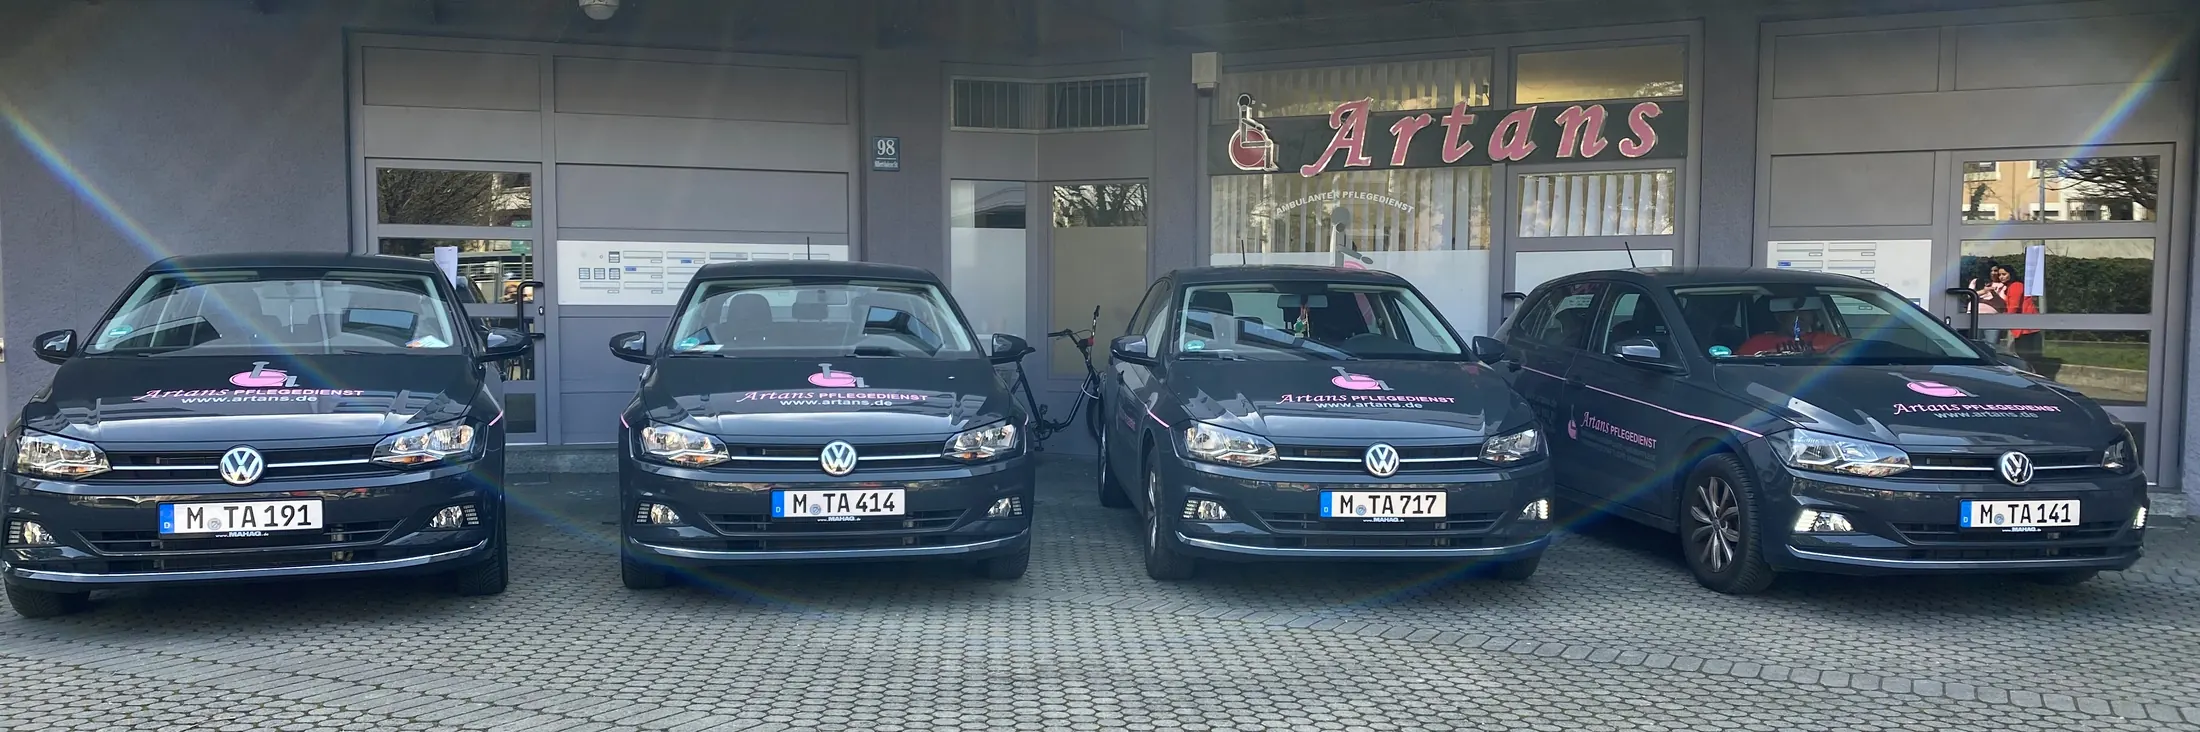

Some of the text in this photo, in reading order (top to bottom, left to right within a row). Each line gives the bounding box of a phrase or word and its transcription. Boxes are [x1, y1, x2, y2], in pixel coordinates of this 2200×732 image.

[1300, 96, 1663, 178] Artans
[877, 139, 895, 156] 98
[1275, 191, 1415, 216] AMBULANTER PFLEGEDIENST
[133, 389, 365, 401] Artans PFLEGEDIENST
[181, 395, 318, 404] www.artans.de
[736, 391, 928, 403] Artans PFLEGEDIENST
[779, 399, 893, 407] www.artans.de
[1276, 394, 1455, 405] Artans PFLEGEDIENST
[1315, 401, 1423, 409] www.artans.de
[1893, 403, 2062, 415] Artans PFLEGEDIENST
[1933, 411, 2039, 419] www.artans.de
[1580, 411, 1611, 435] Artans
[1610, 425, 1657, 450] PFLEGEDIENST
[220, 447, 263, 485] VW
[821, 441, 857, 475] VW
[1366, 443, 1400, 477] VW
[793, 493, 807, 514] M
[823, 493, 850, 513] TA
[855, 492, 895, 513] 414
[1340, 495, 1353, 514] M
[1368, 495, 1394, 514] TA
[1400, 495, 1437, 514] 717
[187, 506, 204, 529] M
[224, 505, 257, 528] TA
[264, 504, 312, 527] 191
[1980, 504, 1993, 524] M
[2008, 504, 2032, 524] TA
[2036, 503, 2071, 523] 141
